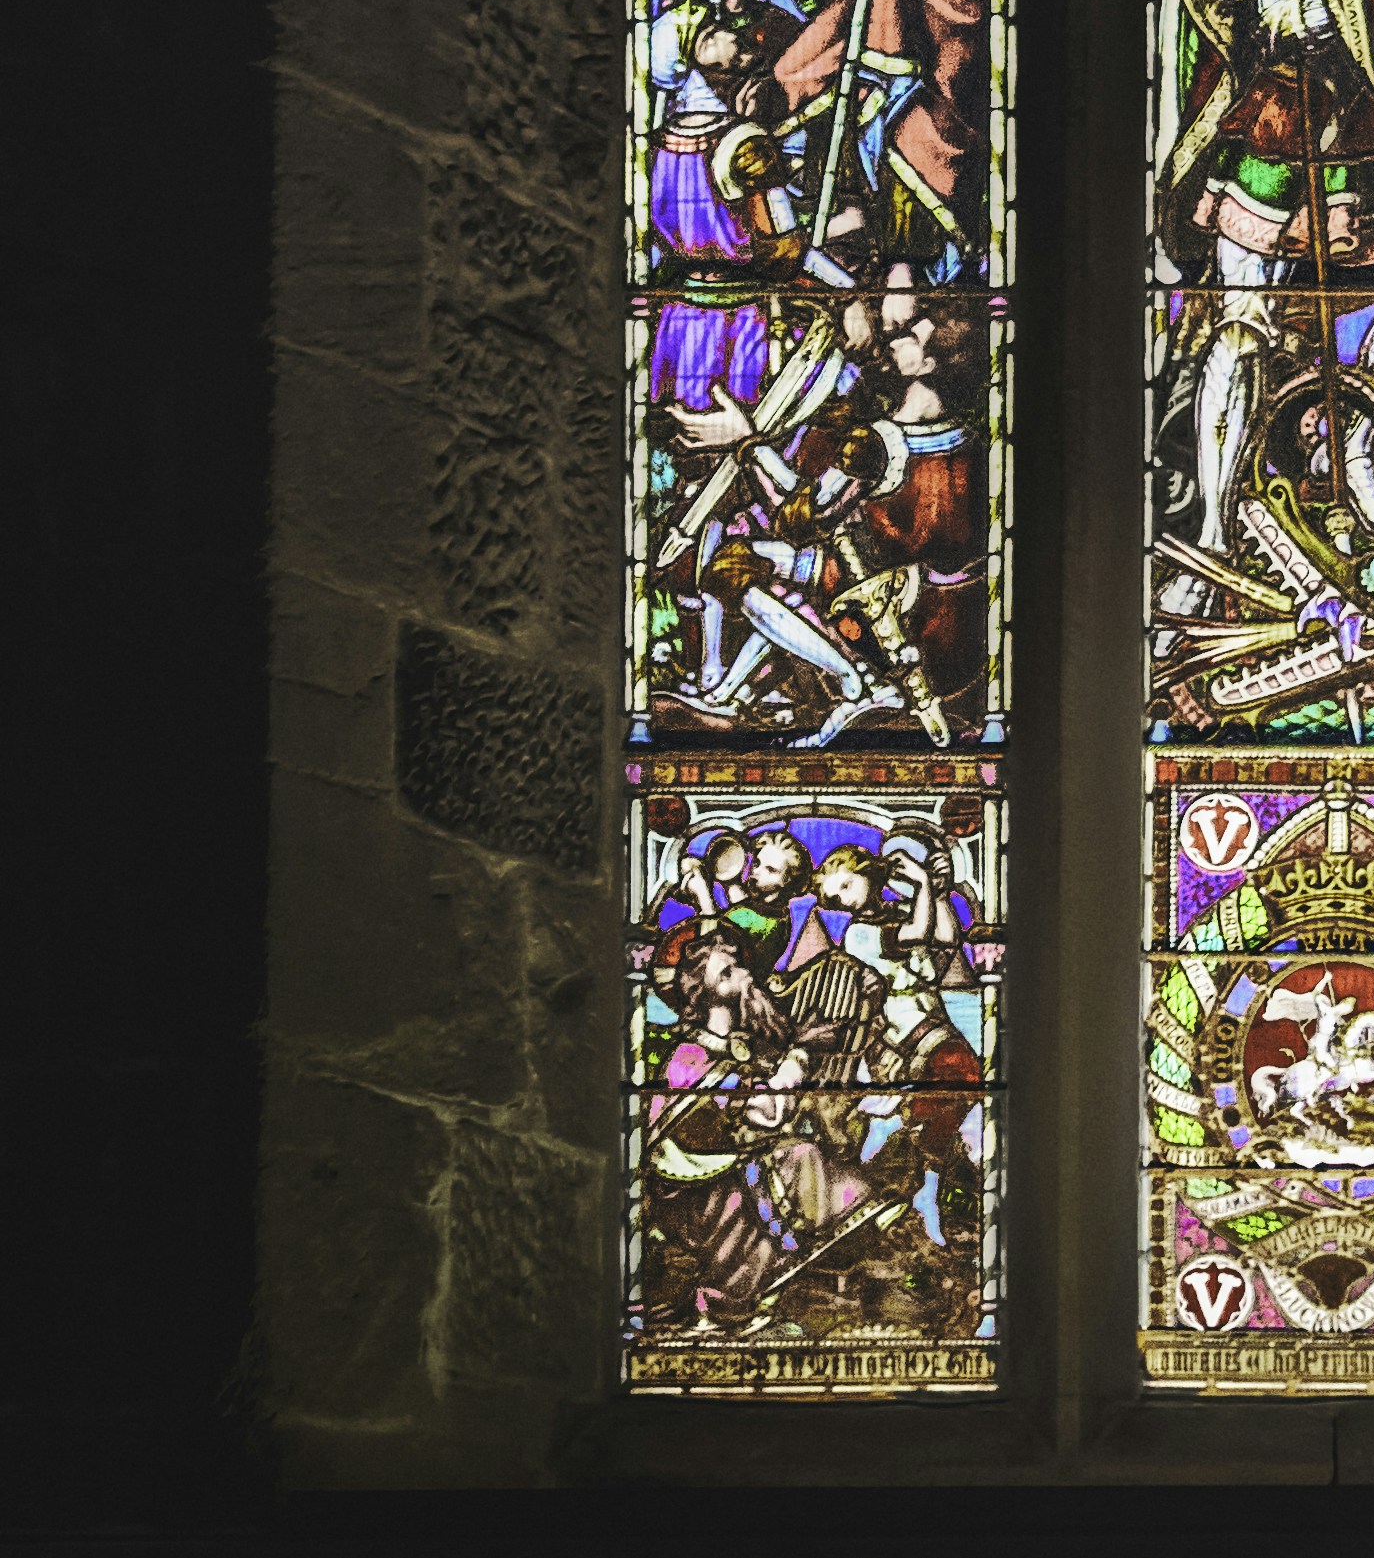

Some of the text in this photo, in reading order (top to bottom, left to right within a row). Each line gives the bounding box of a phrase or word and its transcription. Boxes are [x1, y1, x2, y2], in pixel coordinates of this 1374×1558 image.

[1190, 811, 1251, 865] V
[1297, 928, 1367, 952] FATA
[1213, 1021, 1239, 1081] QUO
[1183, 1272, 1242, 1330] V
